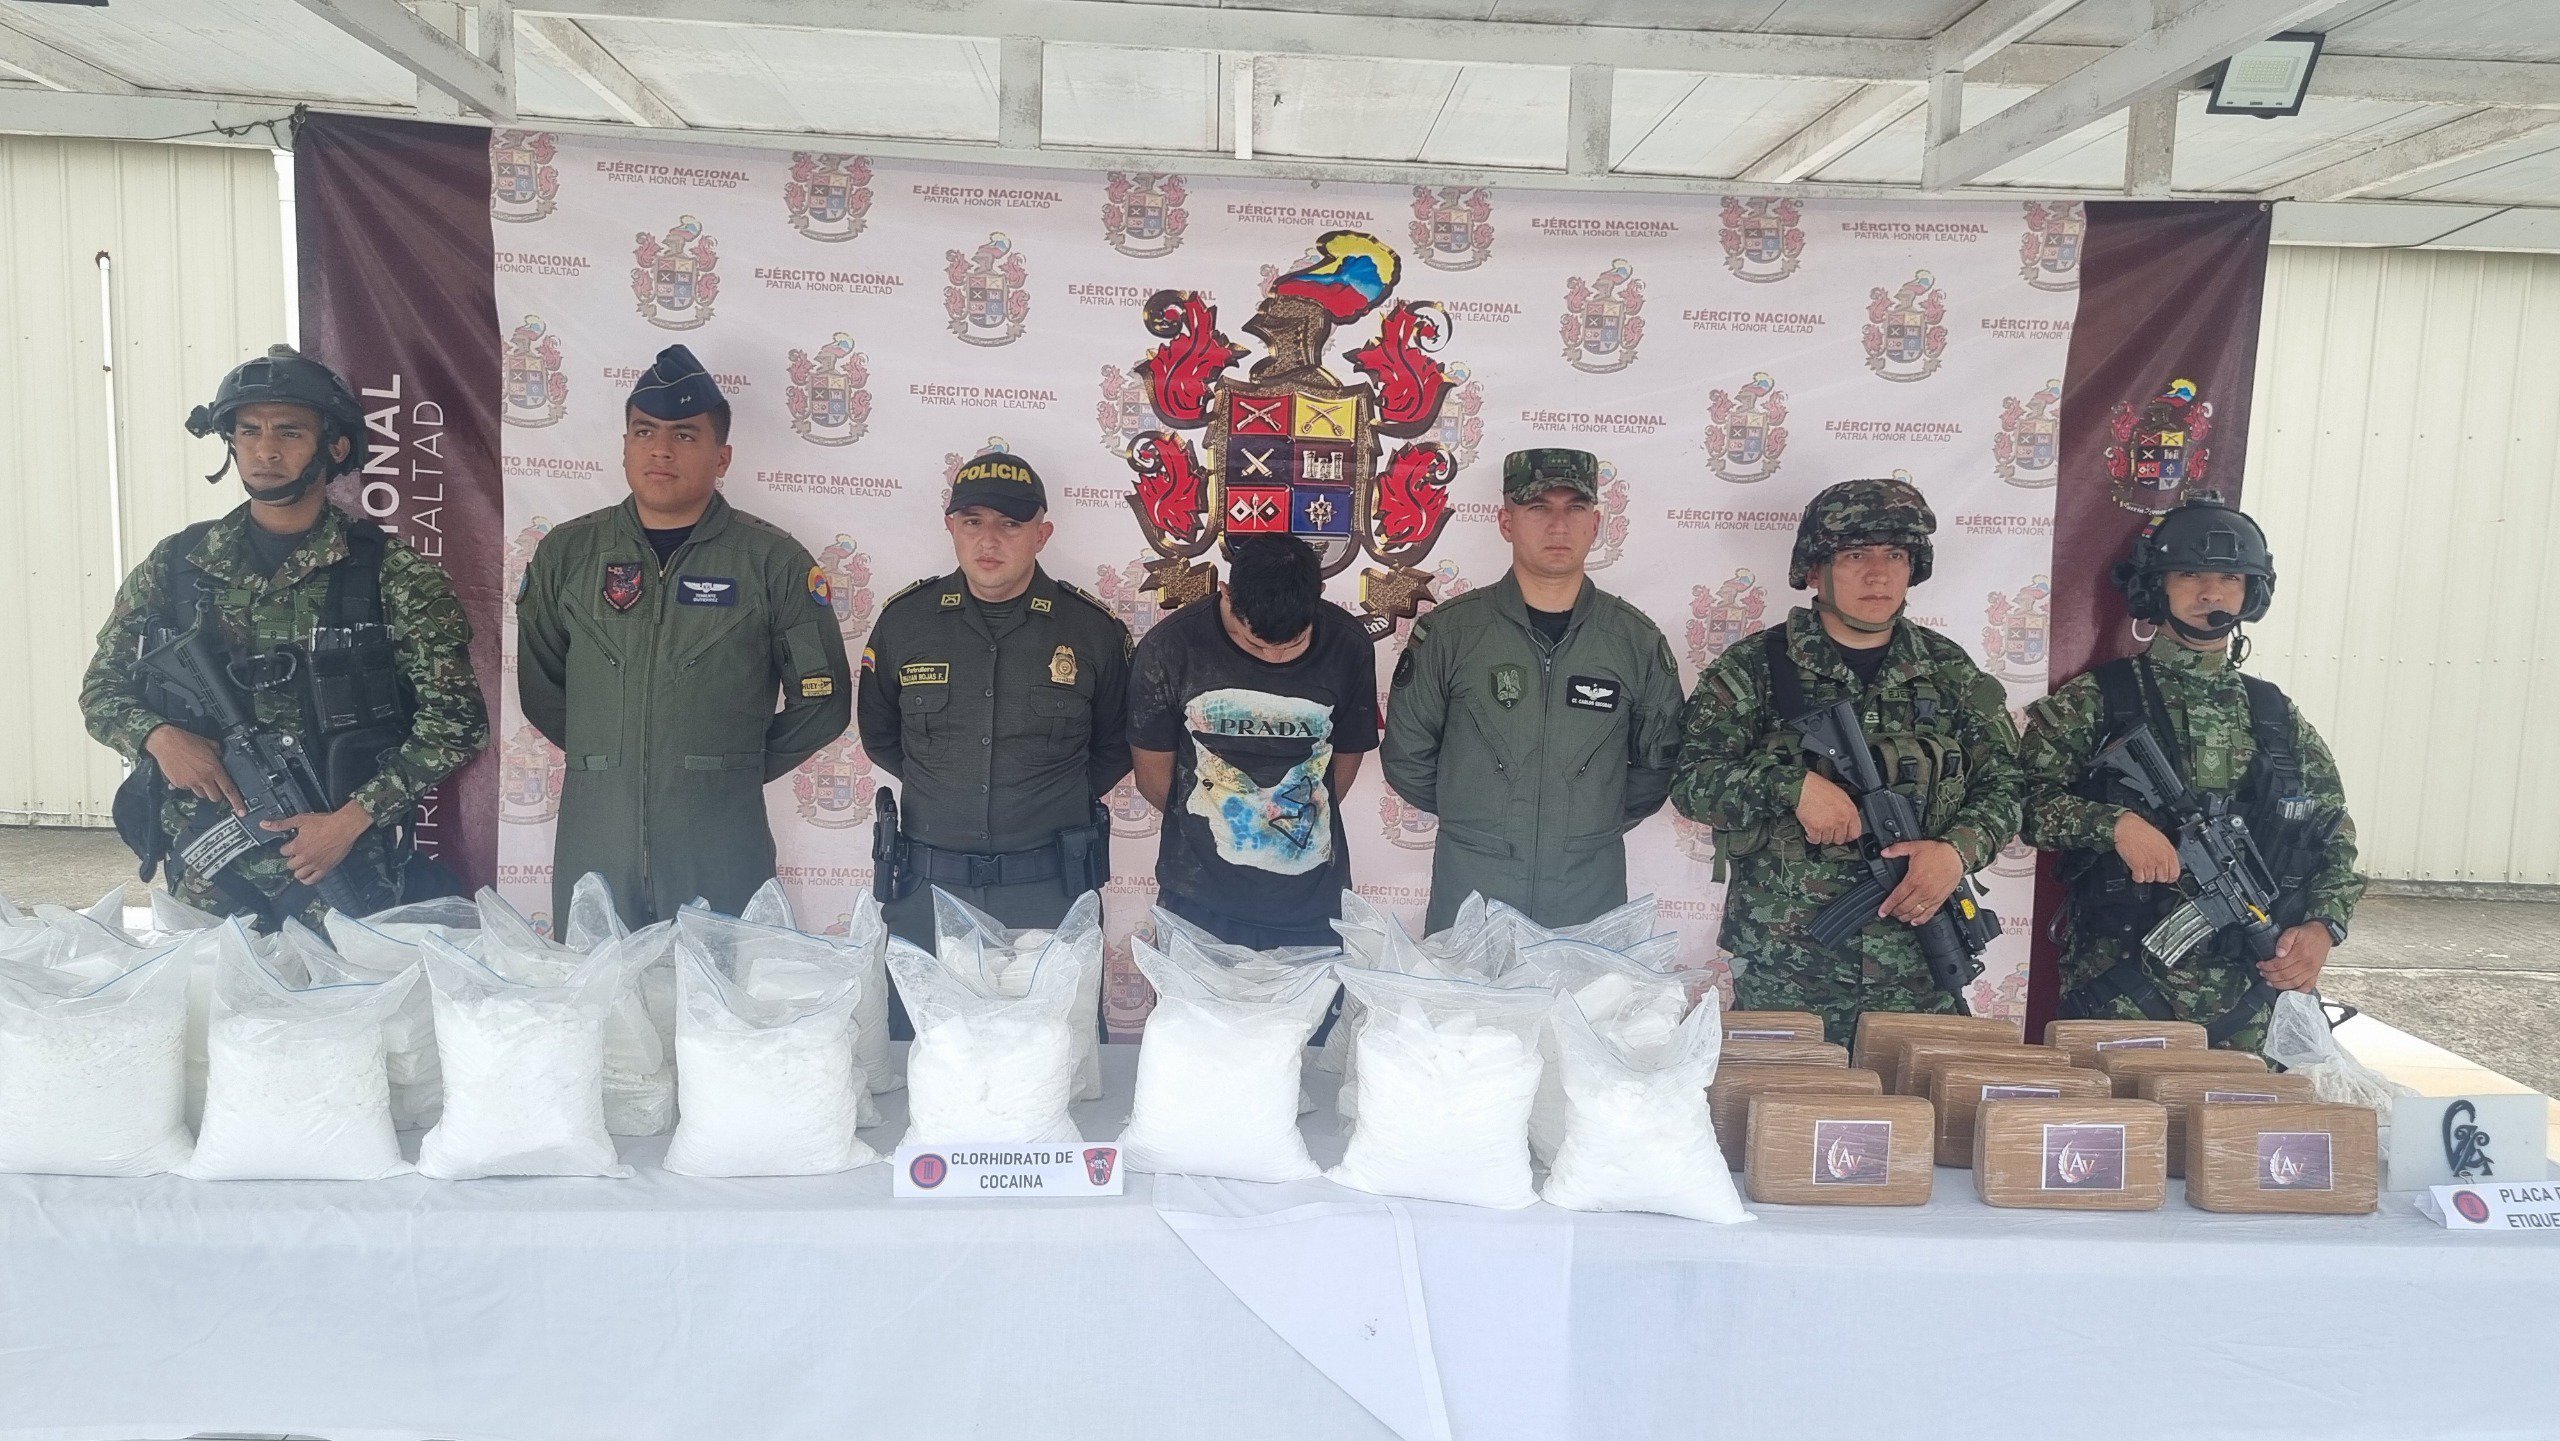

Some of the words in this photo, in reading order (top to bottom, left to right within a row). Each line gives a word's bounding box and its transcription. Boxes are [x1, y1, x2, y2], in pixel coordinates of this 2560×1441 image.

[597, 161, 668, 175] EJÉRCITO
[674, 168, 749, 181] NACIONAL
[609, 173, 644, 183] PATRIA
[650, 176, 686, 186] HONOR
[693, 179, 737, 188] LEALTAD
[913, 184, 983, 197] EJÉRCITO
[989, 189, 1062, 201] NACIONAL
[924, 196, 959, 204] PATRIA
[965, 198, 1000, 206] HONOR
[1007, 200, 1050, 209] LEALTAD
[1227, 204, 1296, 216] EJÉRCITO
[1302, 209, 1374, 221] NACIONAL
[1239, 215, 1273, 223] PATRIA
[1279, 217, 1314, 225] HONOR
[1320, 219, 1363, 228] LEALTAD
[1532, 217, 1600, 229] EJÉRCITO
[1605, 220, 1678, 231] NACIONAL
[1842, 221, 1911, 232] EJÉRCITO
[1915, 224, 1988, 233] NACIONAL
[1583, 229, 1619, 237] HONOR
[1625, 230, 1668, 238] LEALTAD
[1894, 233, 1930, 241] HONOR
[1935, 234, 1977, 242] LEALTAD
[519, 254, 590, 267] NACIONAL
[496, 264, 533, 273] HONOR
[539, 266, 580, 276] LEALTAD
[755, 267, 825, 281] EJÉRCITO
[831, 272, 903, 286] NACIONAL
[766, 280, 801, 289] PATRIA
[807, 283, 844, 292] HONOR
[850, 285, 893, 294] LEALTAD
[1068, 283, 1138, 298] EJÉRCITO
[1080, 296, 1115, 305] PATRIA
[1449, 301, 1521, 314] NACIONAL
[1468, 313, 1509, 323] LEALTAD
[1683, 309, 1750, 322] EJÉRCITO
[1755, 313, 1825, 325] NACIONAL
[1982, 317, 2048, 330] EJÉRCITO
[1693, 322, 1726, 330] PATRIA
[1732, 324, 1767, 332] HONOR
[1773, 325, 1813, 334] LEALTAD
[1992, 330, 2025, 339] PATRIA
[2030, 331, 2062, 339] HONOR
[910, 383, 979, 397] EJÉRCITO
[985, 389, 1057, 401] NACIONAL
[921, 397, 956, 406] PATRIA
[961, 398, 997, 408] HONOR
[1003, 401, 1046, 410] LEALTAD
[1522, 410, 1589, 422] EJÉRCITO
[1595, 414, 1666, 425] NACIONAL
[1533, 423, 1566, 431] PATRIA
[1572, 424, 1607, 432] HONOR
[1613, 425, 1655, 434] LEALTAD
[1825, 419, 1891, 431] EJÉRCITO
[1895, 422, 1962, 433] NACIONAL
[1835, 432, 1867, 440] PATRIA
[1872, 433, 1906, 441] HONOR
[1911, 433, 1951, 442] LEALTAD
[527, 458, 603, 472] NACIONAL
[504, 467, 541, 477] HONOR
[547, 470, 592, 480] LEALTAD
[757, 471, 826, 485] EJÉRCITO
[831, 476, 902, 489] NACIONAL
[956, 463, 1032, 484] POLICIA
[769, 484, 803, 492] PATRIA
[809, 485, 844, 495] HONOR
[850, 488, 892, 498] LEALTAD
[1076, 498, 1109, 508] PATRIA
[1667, 508, 1733, 520] EJÉRCITO
[1955, 514, 2026, 526] EJÉRCITO
[1677, 520, 1709, 529] PATRIA
[1714, 522, 1748, 530] HONOR
[1754, 523, 1794, 531] LEALTAD
[1967, 527, 2000, 535] PATRIA
[2008, 527, 2044, 535] HONOR
[1220, 719, 1313, 736] PRADA
[809, 878, 844, 886] HONOR
[952, 1151, 1050, 1165] CLORHIDRATO
[1056, 1151, 1074, 1164] DE
[980, 1174, 1043, 1189] COCAINA
[2499, 1187, 2552, 1203] PLACA
